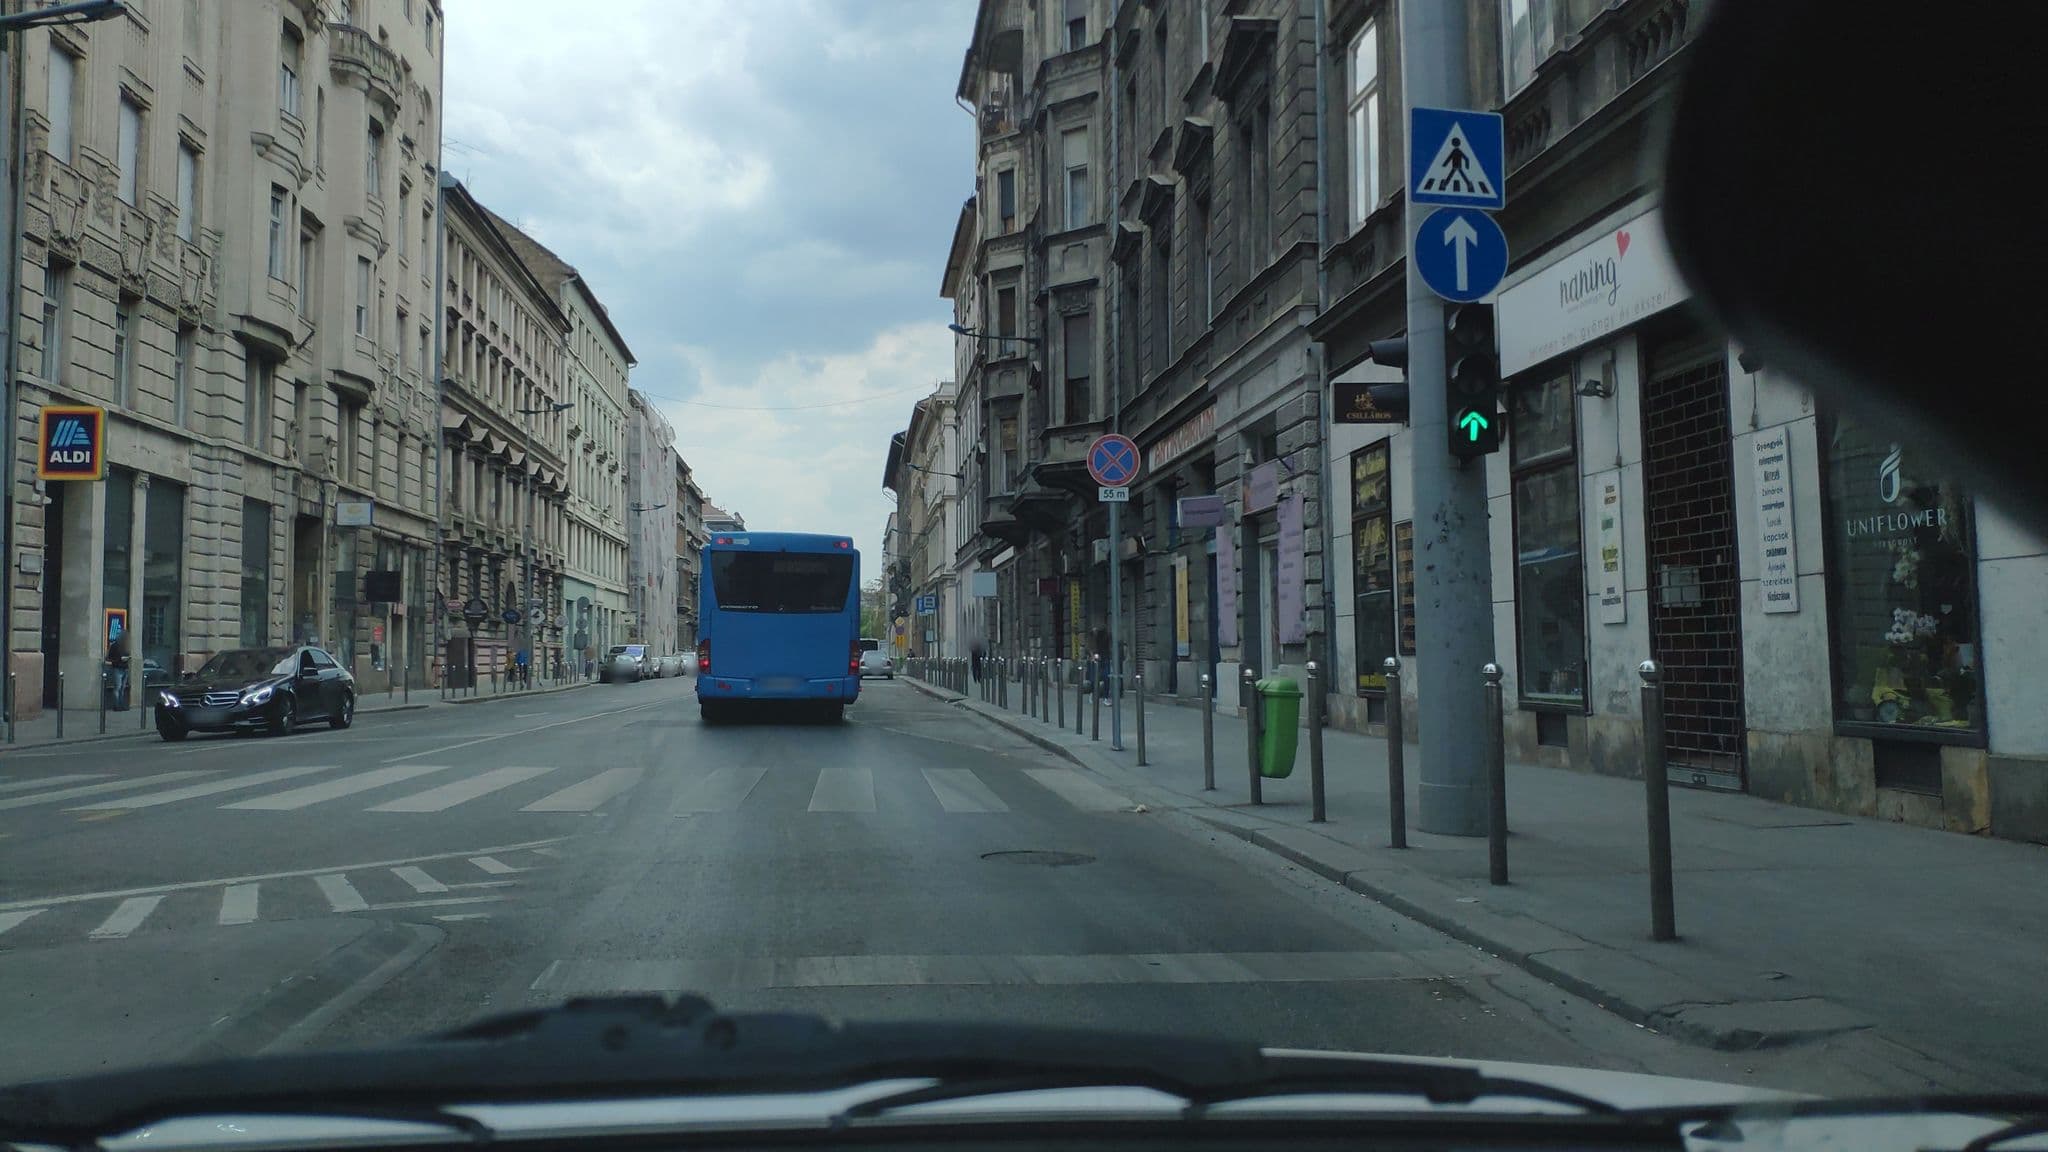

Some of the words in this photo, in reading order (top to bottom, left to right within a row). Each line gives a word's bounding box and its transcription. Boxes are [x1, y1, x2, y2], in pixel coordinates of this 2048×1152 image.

[50, 450, 91, 463] ALDI
[1104, 489, 1114, 498] 55
[1847, 508, 1948, 537] UNIFLOWER
